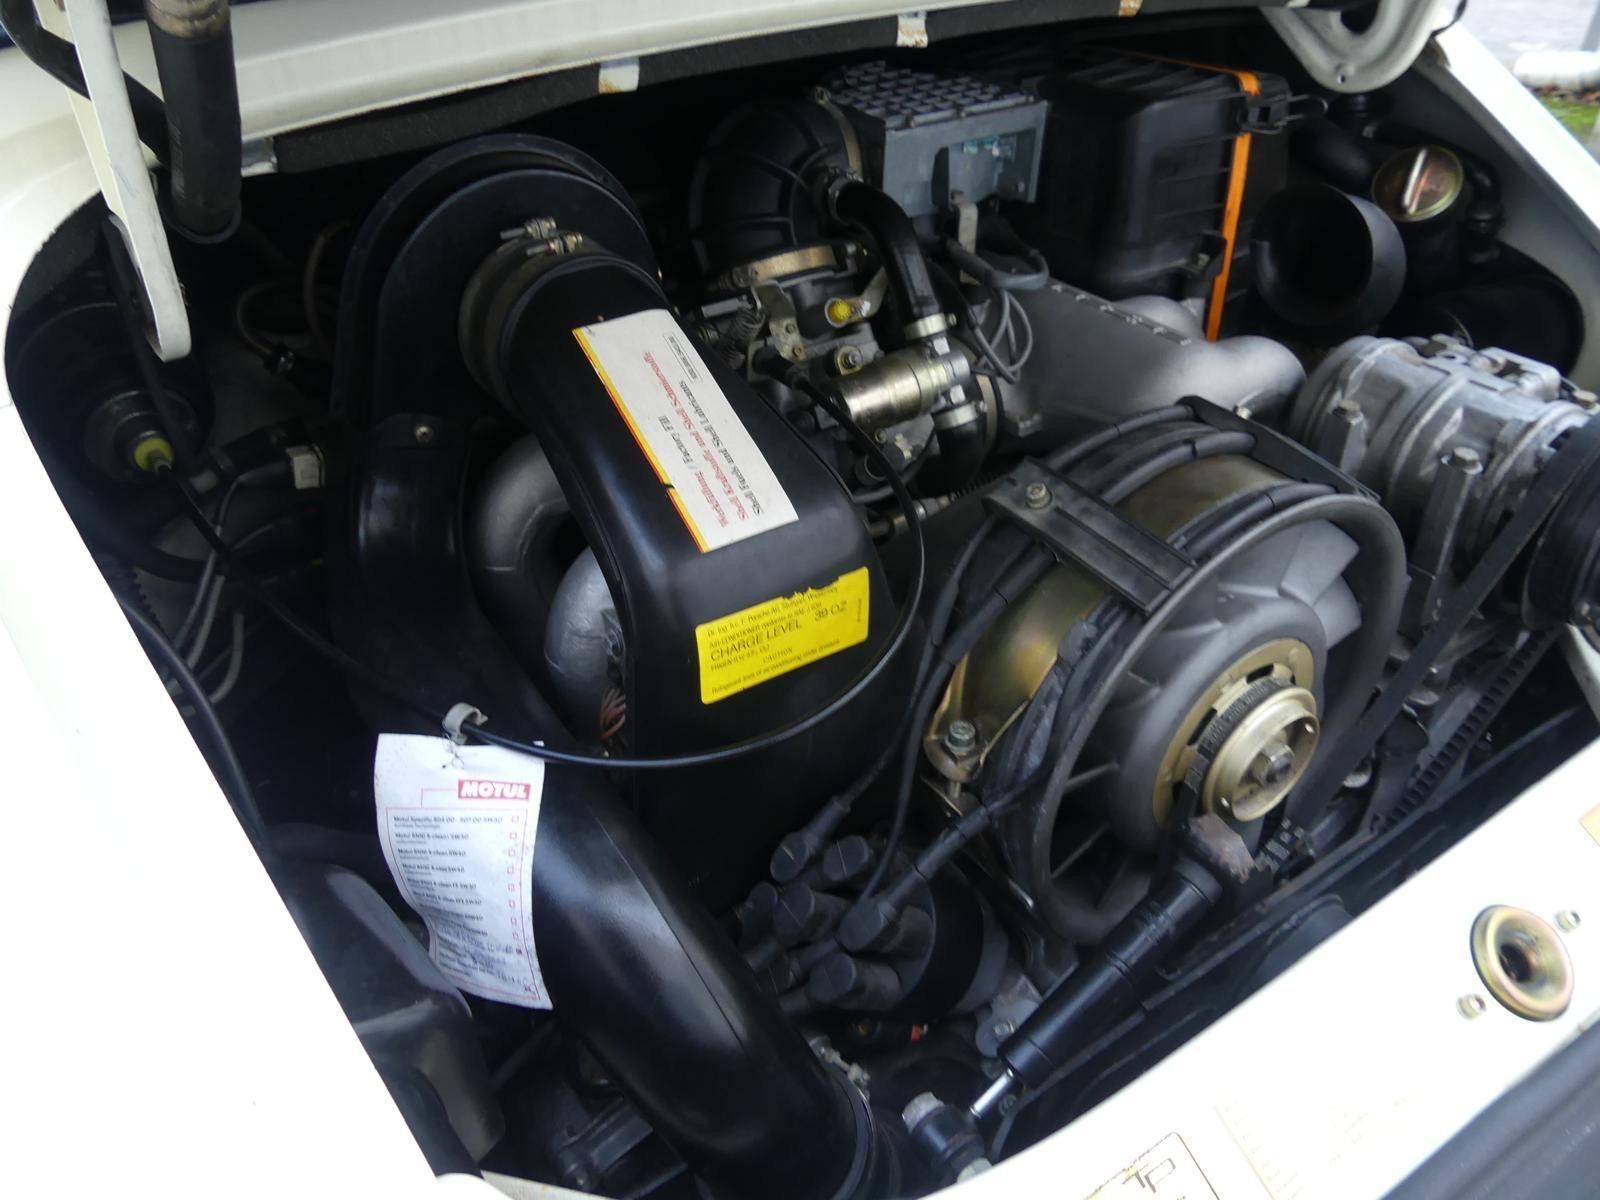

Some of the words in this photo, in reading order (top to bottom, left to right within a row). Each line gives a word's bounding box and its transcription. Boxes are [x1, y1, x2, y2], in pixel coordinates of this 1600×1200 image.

[679, 381, 708, 424] Lubricants
[658, 415, 674, 432] Fill
[676, 408, 694, 431] Shell
[672, 432, 693, 464] Factory
[689, 431, 705, 447] und
[703, 424, 722, 448] Shell
[718, 448, 734, 465] and
[733, 466, 749, 490] Fuels
[730, 494, 749, 520] Shell
[744, 490, 763, 516] Shell
[711, 633, 763, 661] CHARGE
[767, 620, 802, 640] LEVEL
[814, 608, 828, 622] 39
[830, 600, 847, 616] OZ
[461, 781, 527, 799] MOTUL
